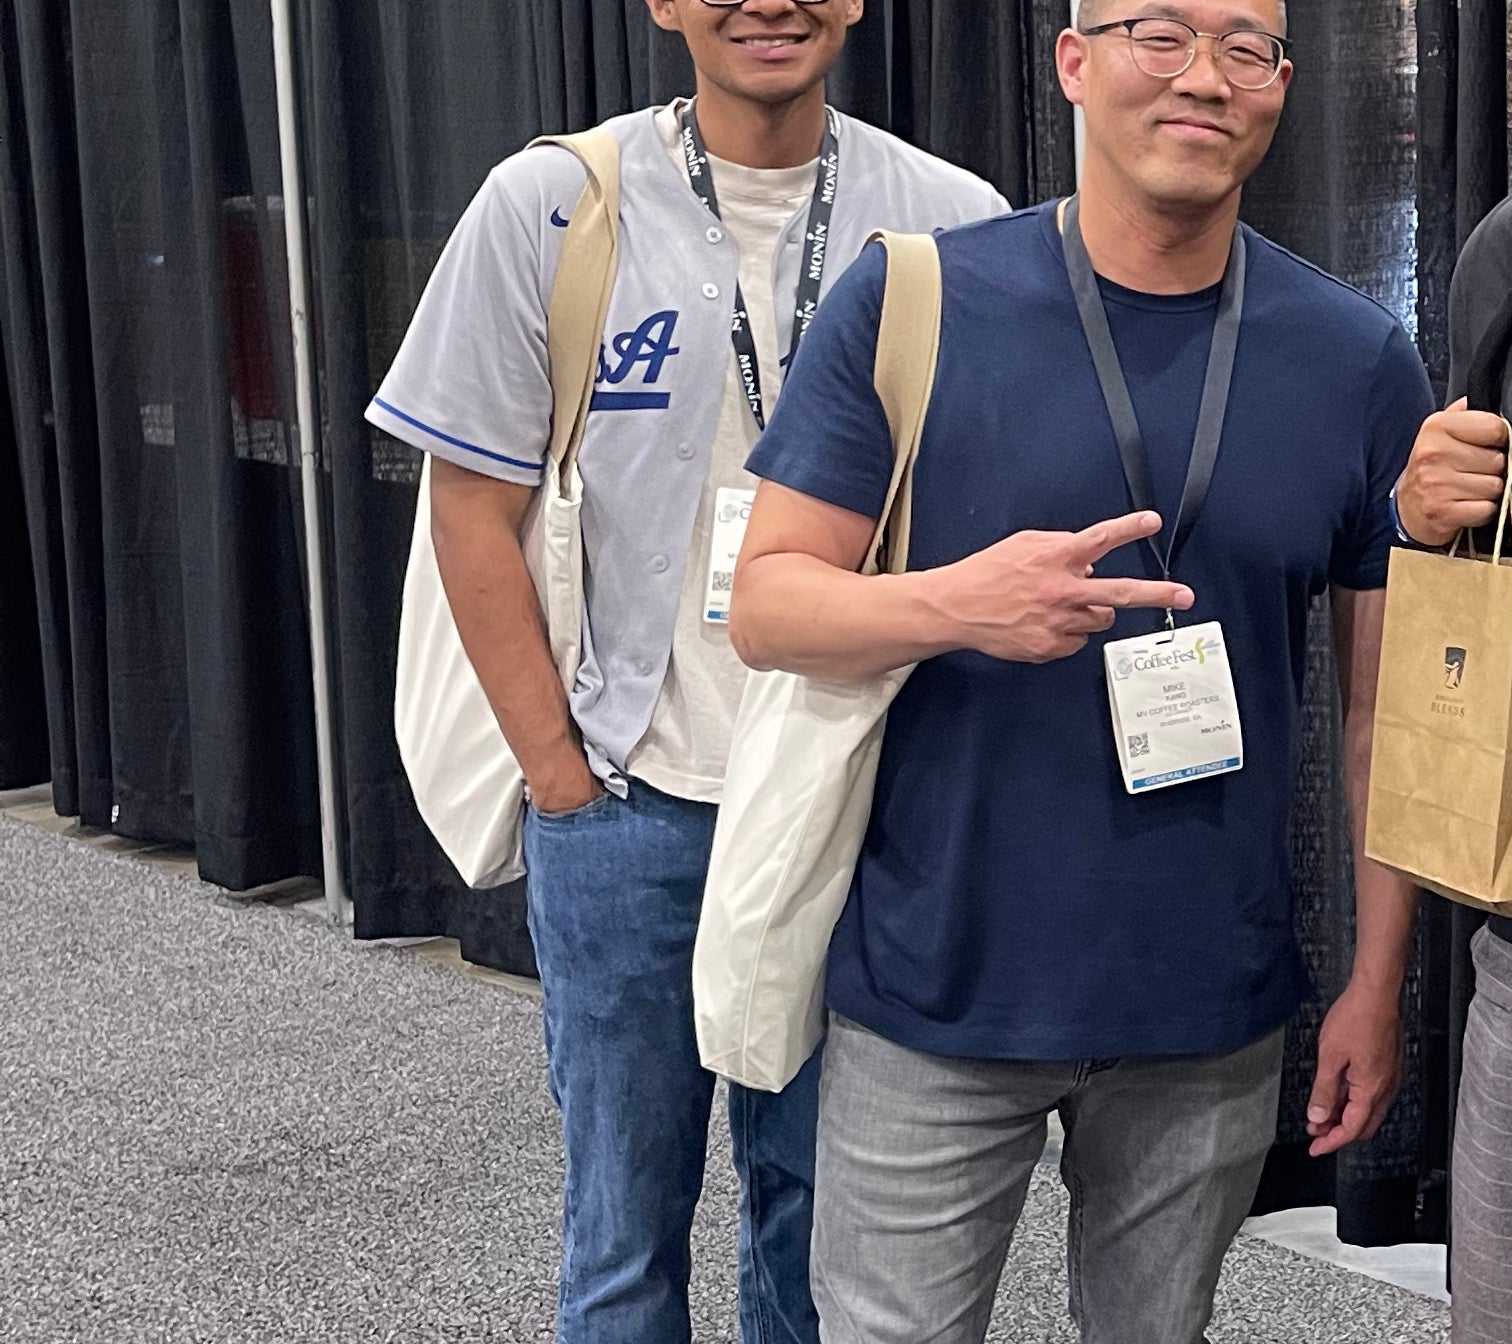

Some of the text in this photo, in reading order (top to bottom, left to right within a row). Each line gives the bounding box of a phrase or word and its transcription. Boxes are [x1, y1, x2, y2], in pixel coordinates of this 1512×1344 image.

[1162, 681, 1187, 694] MIKE
[1148, 703, 1178, 716] COFFEE
[1144, 769, 1184, 786] GENERAL
[1185, 759, 1228, 776] ATTENDEE
